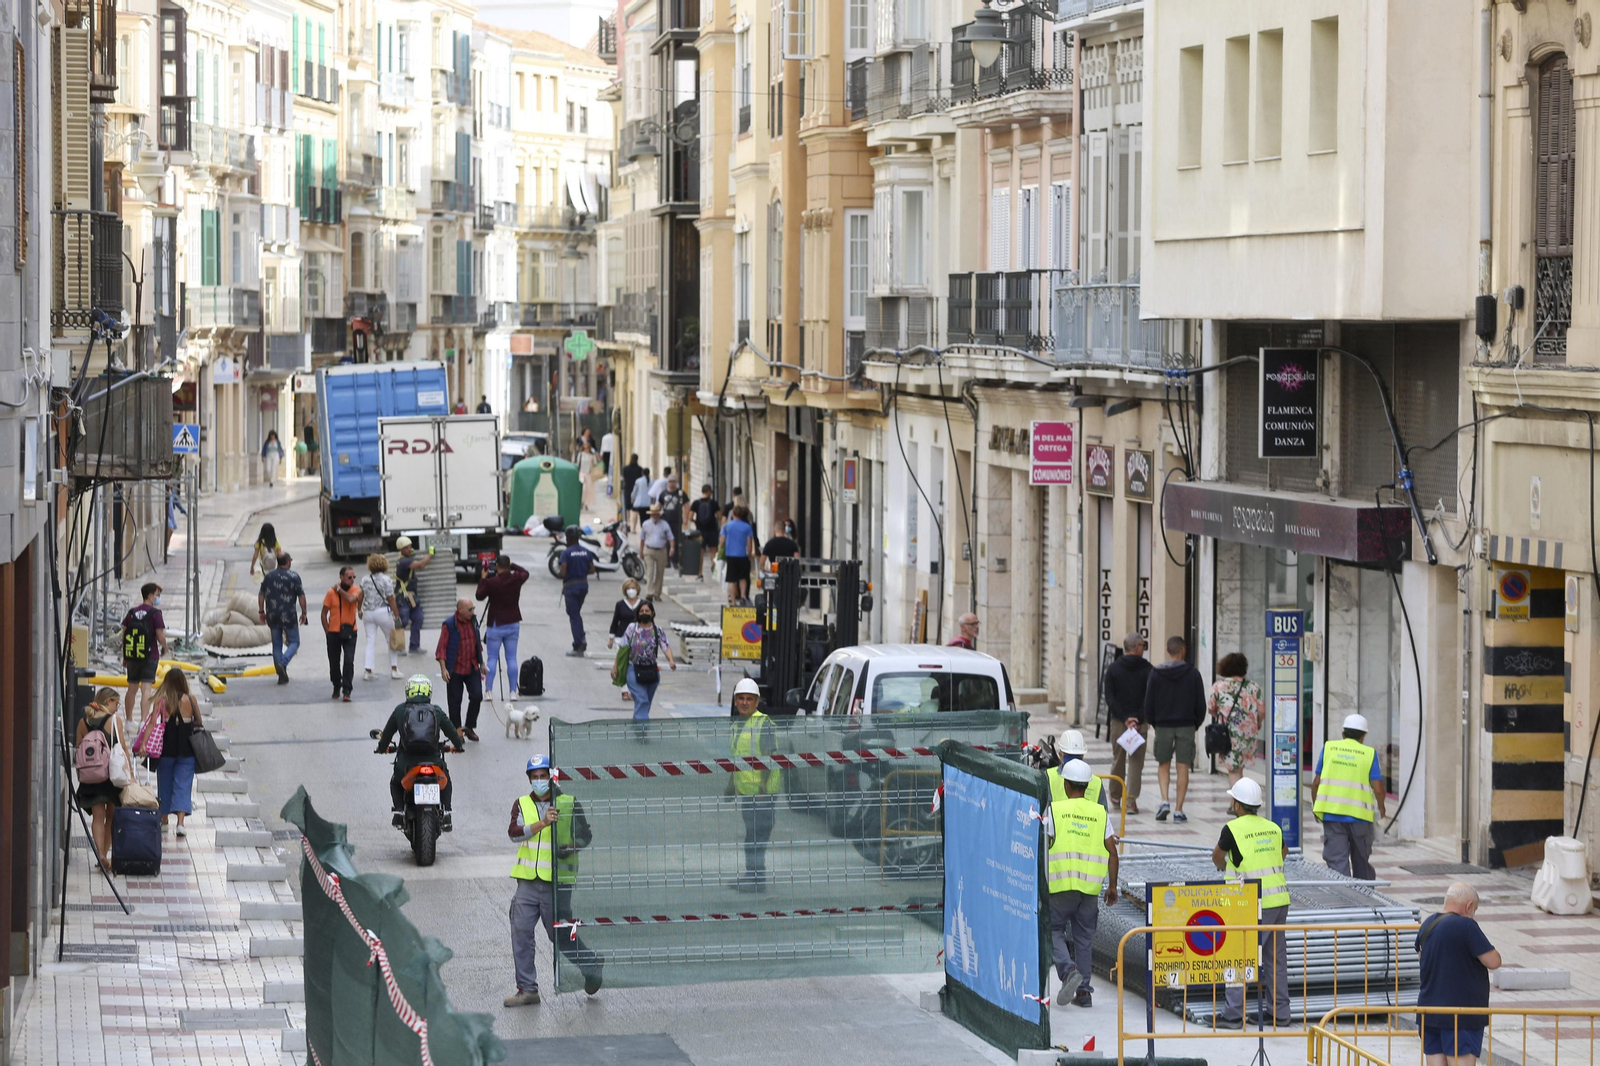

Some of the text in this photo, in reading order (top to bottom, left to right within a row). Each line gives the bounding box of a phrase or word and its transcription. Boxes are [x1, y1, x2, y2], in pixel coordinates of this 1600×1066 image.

[1267, 406, 1312, 415] FLAMENCA
[1265, 420, 1314, 430] COMUNIÓN
[388, 438, 454, 455] RDA
[1034, 469, 1070, 481] COMUNIONES
[397, 504, 487, 513] rdaramoeda.com
[1284, 524, 1299, 534] DANZA
[1102, 569, 1111, 641] TATTOO
[1140, 578, 1149, 651] TATTOO
[1274, 616, 1297, 633] BUS
[1278, 654, 1294, 666] 36
[1072, 814, 1097, 822] CARRETERÍA
[1178, 887, 1244, 897] POLICIA LOCAL
[1192, 898, 1231, 907] MALAGA
[1155, 961, 1190, 972] PROHIBIDO
[1192, 959, 1232, 970] ESTACIONAR
[1155, 975, 1167, 984] LAS
[1170, 973, 1177, 983] 7
[1199, 973, 1211, 982] DEL
[1215, 972, 1224, 981] DIA
[1226, 970, 1232, 979] 4
[1246, 968, 1252, 978] 8
